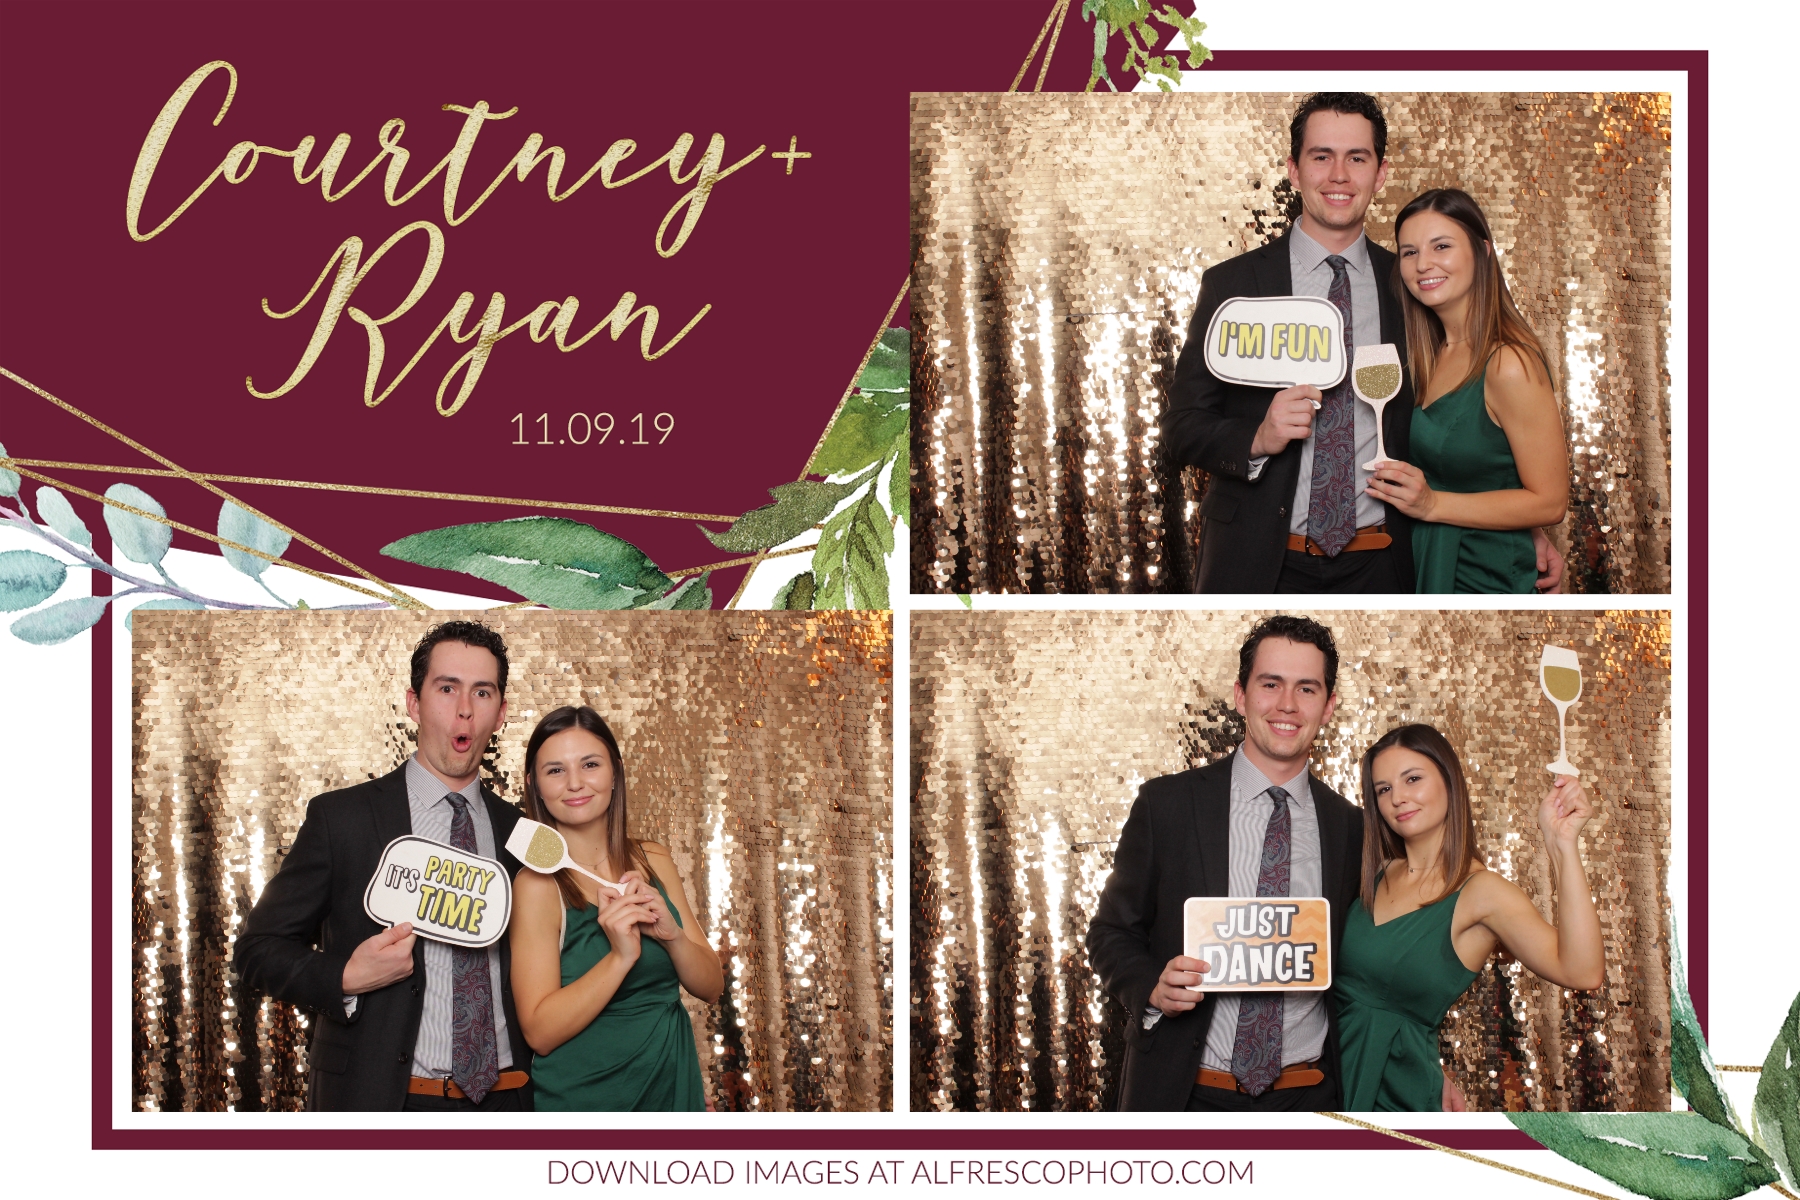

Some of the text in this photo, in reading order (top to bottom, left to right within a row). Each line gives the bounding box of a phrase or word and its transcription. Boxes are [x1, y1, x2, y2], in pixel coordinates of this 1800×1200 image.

[1218, 319, 1331, 362] I'M FUN
[385, 863, 420, 893] IT'S
[424, 855, 495, 895] PARTY
[417, 884, 486, 936] TIME
[1213, 902, 1299, 941] JUST
[1202, 941, 1317, 985] DANCE
